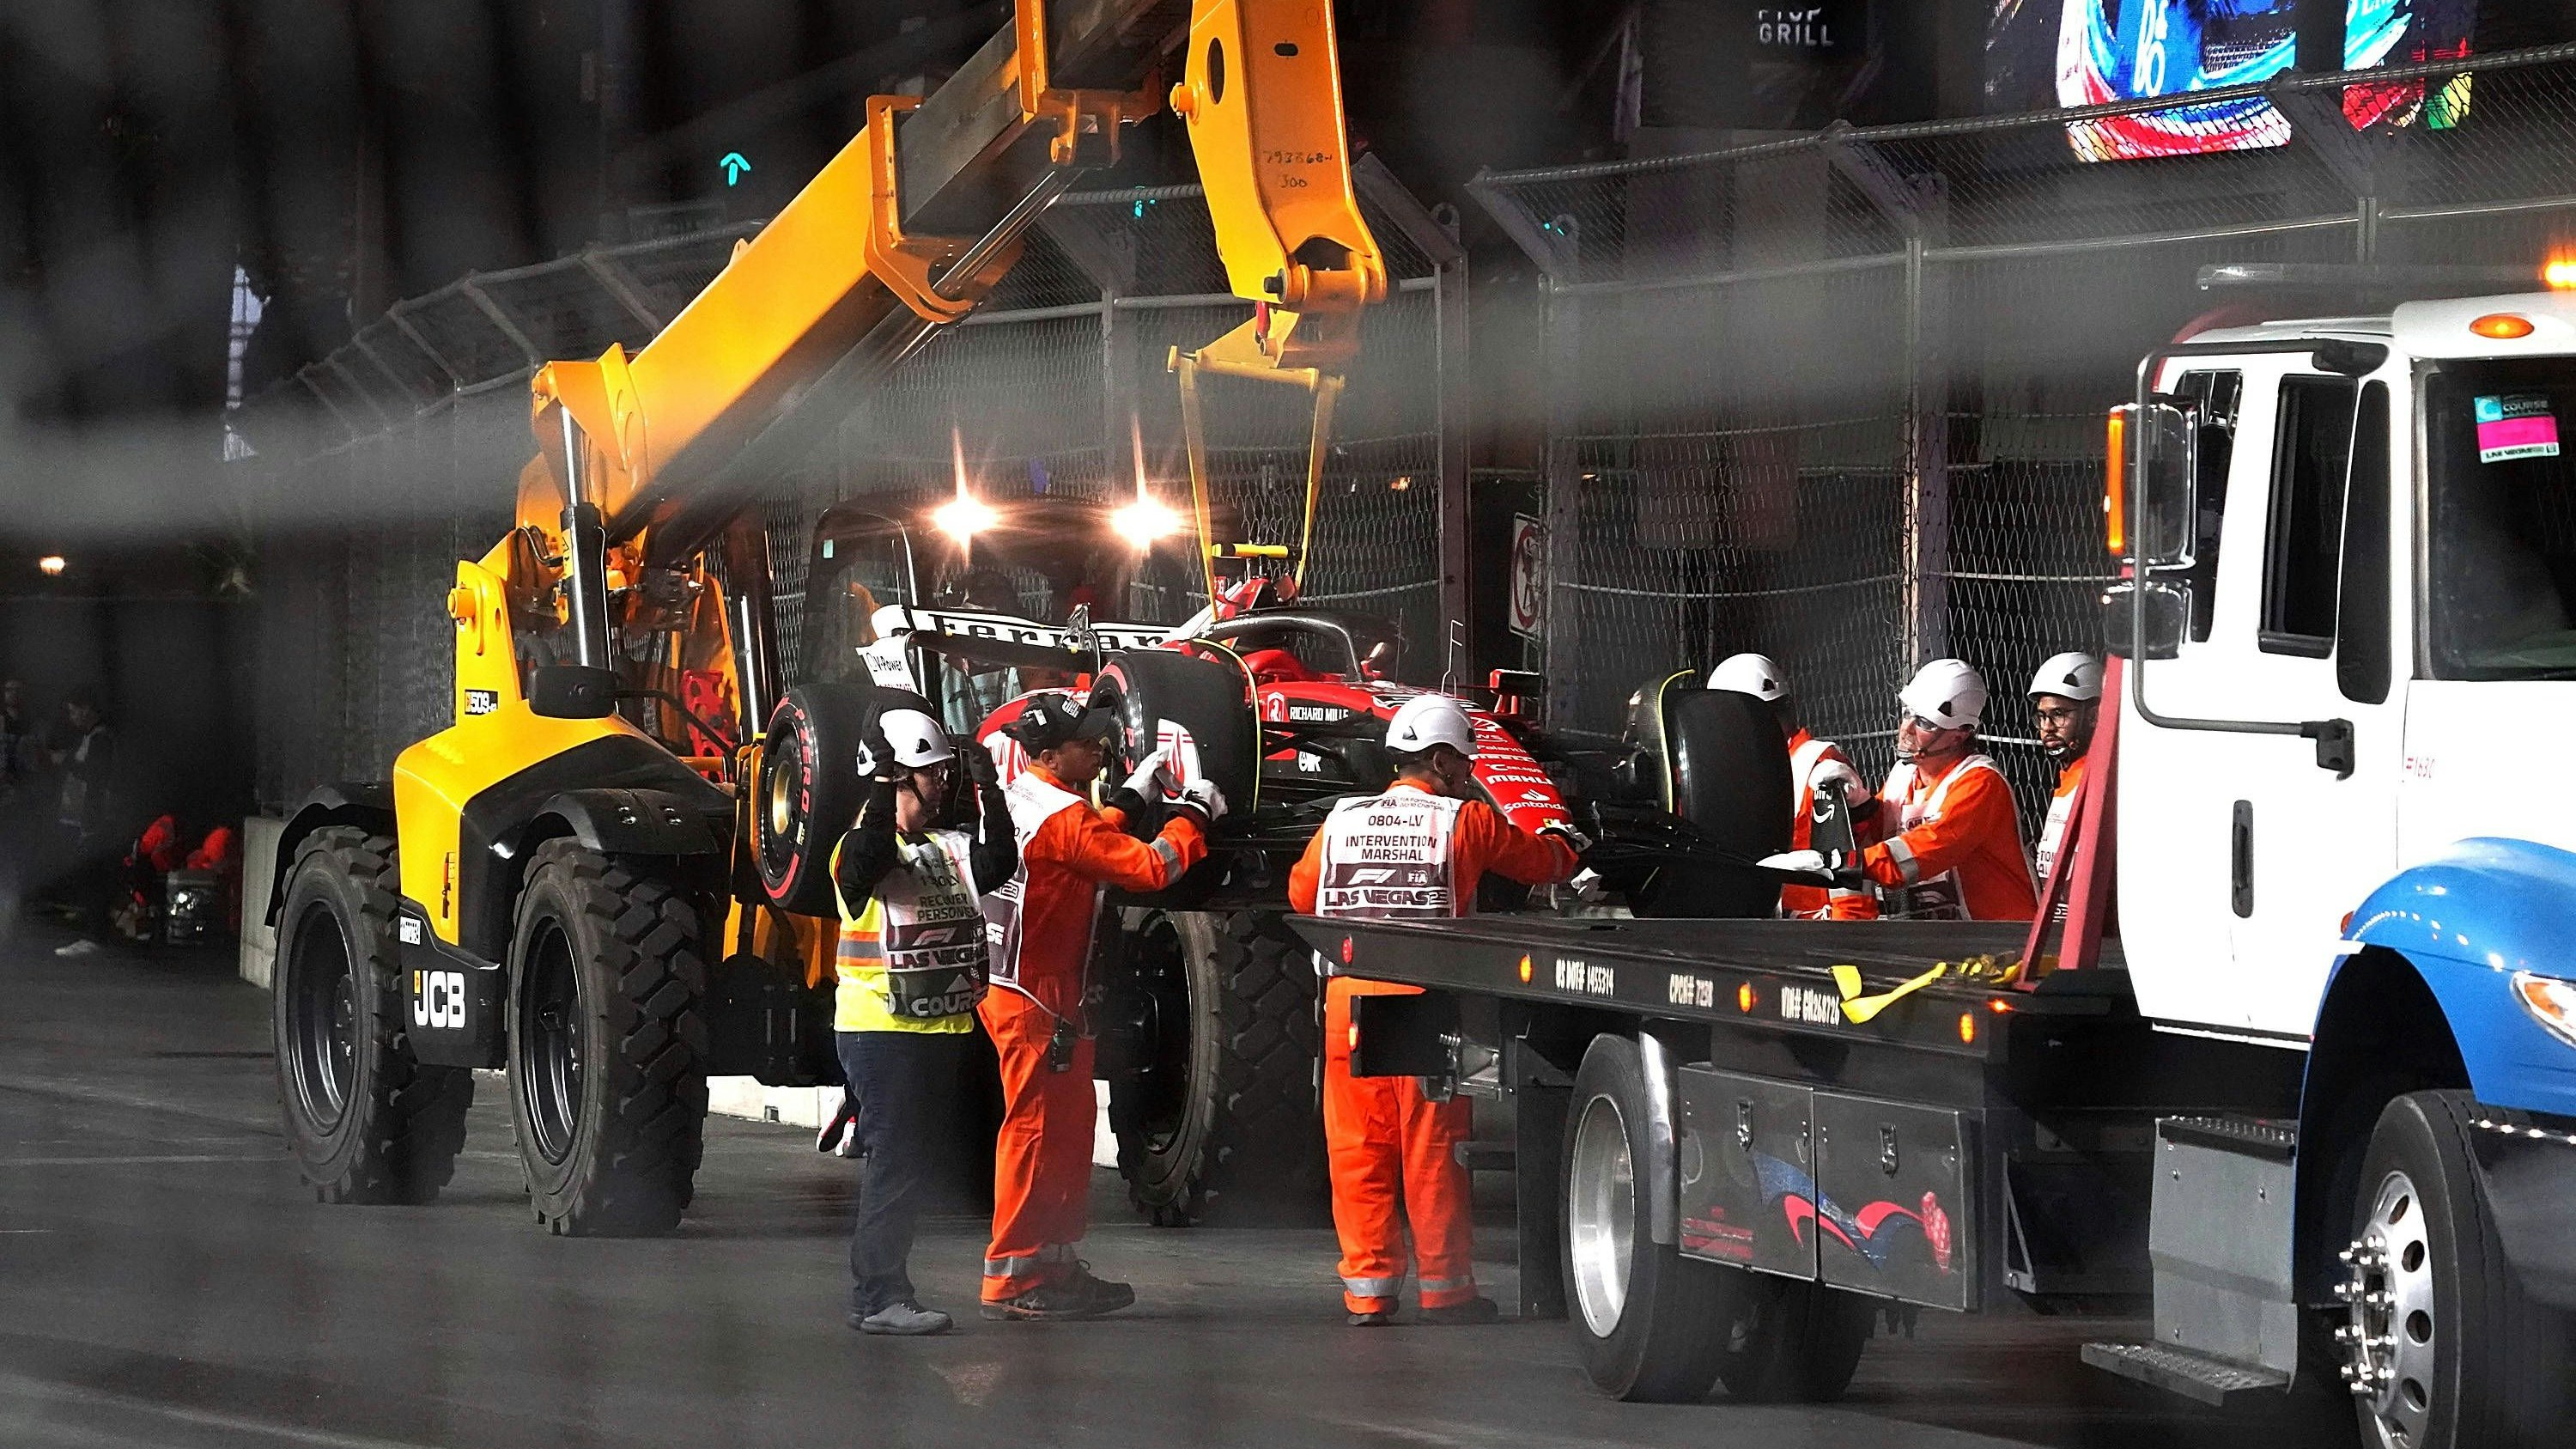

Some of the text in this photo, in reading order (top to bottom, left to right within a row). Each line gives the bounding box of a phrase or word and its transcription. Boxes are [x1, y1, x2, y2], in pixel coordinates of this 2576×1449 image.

[1759, 23, 1834, 46] GRILL
[873, 655, 903, 672] V-Power
[1290, 706, 1323, 721] RICHARD
[1368, 815, 1424, 826] 0804-LV
[1346, 835, 1437, 849] INTERVENTION
[1361, 849, 1424, 861] MARSHAL
[1325, 891, 1359, 906] LAS
[413, 970, 466, 1029] JCB
[1781, 986, 1801, 1019] VIN#
